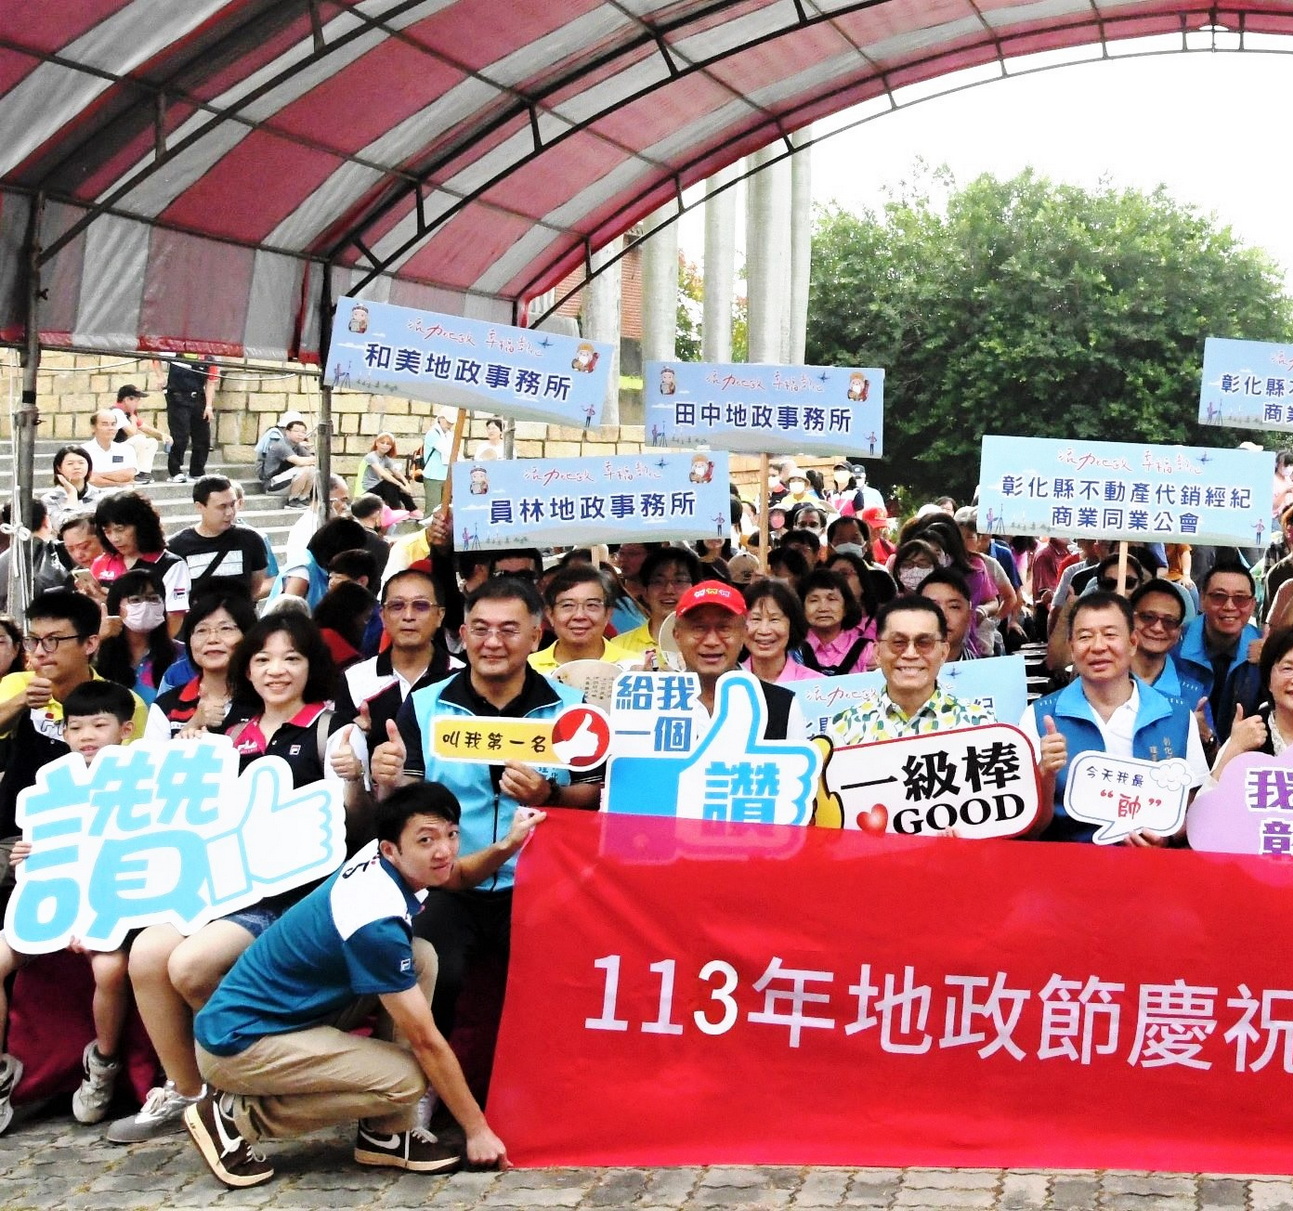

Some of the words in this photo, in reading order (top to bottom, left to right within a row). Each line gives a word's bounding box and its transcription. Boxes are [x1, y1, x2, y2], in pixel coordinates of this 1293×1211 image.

[363, 341, 573, 402] 和美地政事務所
[674, 401, 853, 433] 田中地政事務所
[489, 489, 697, 525] 員林地政事務所
[1000, 474, 1253, 511] 彰化縣不動產代銷經紀
[1050, 504, 1201, 535] 商業同業公會
[615, 675, 695, 711] 給我
[441, 730, 547, 754] 叫我第一名
[614, 716, 692, 752] 一個
[840, 741, 1022, 803] 一級棒
[1086, 765, 1145, 789] 今天我最
[702, 761, 780, 828] 讚
[892, 793, 1026, 836] GOOD
[13, 744, 226, 942] 讚
